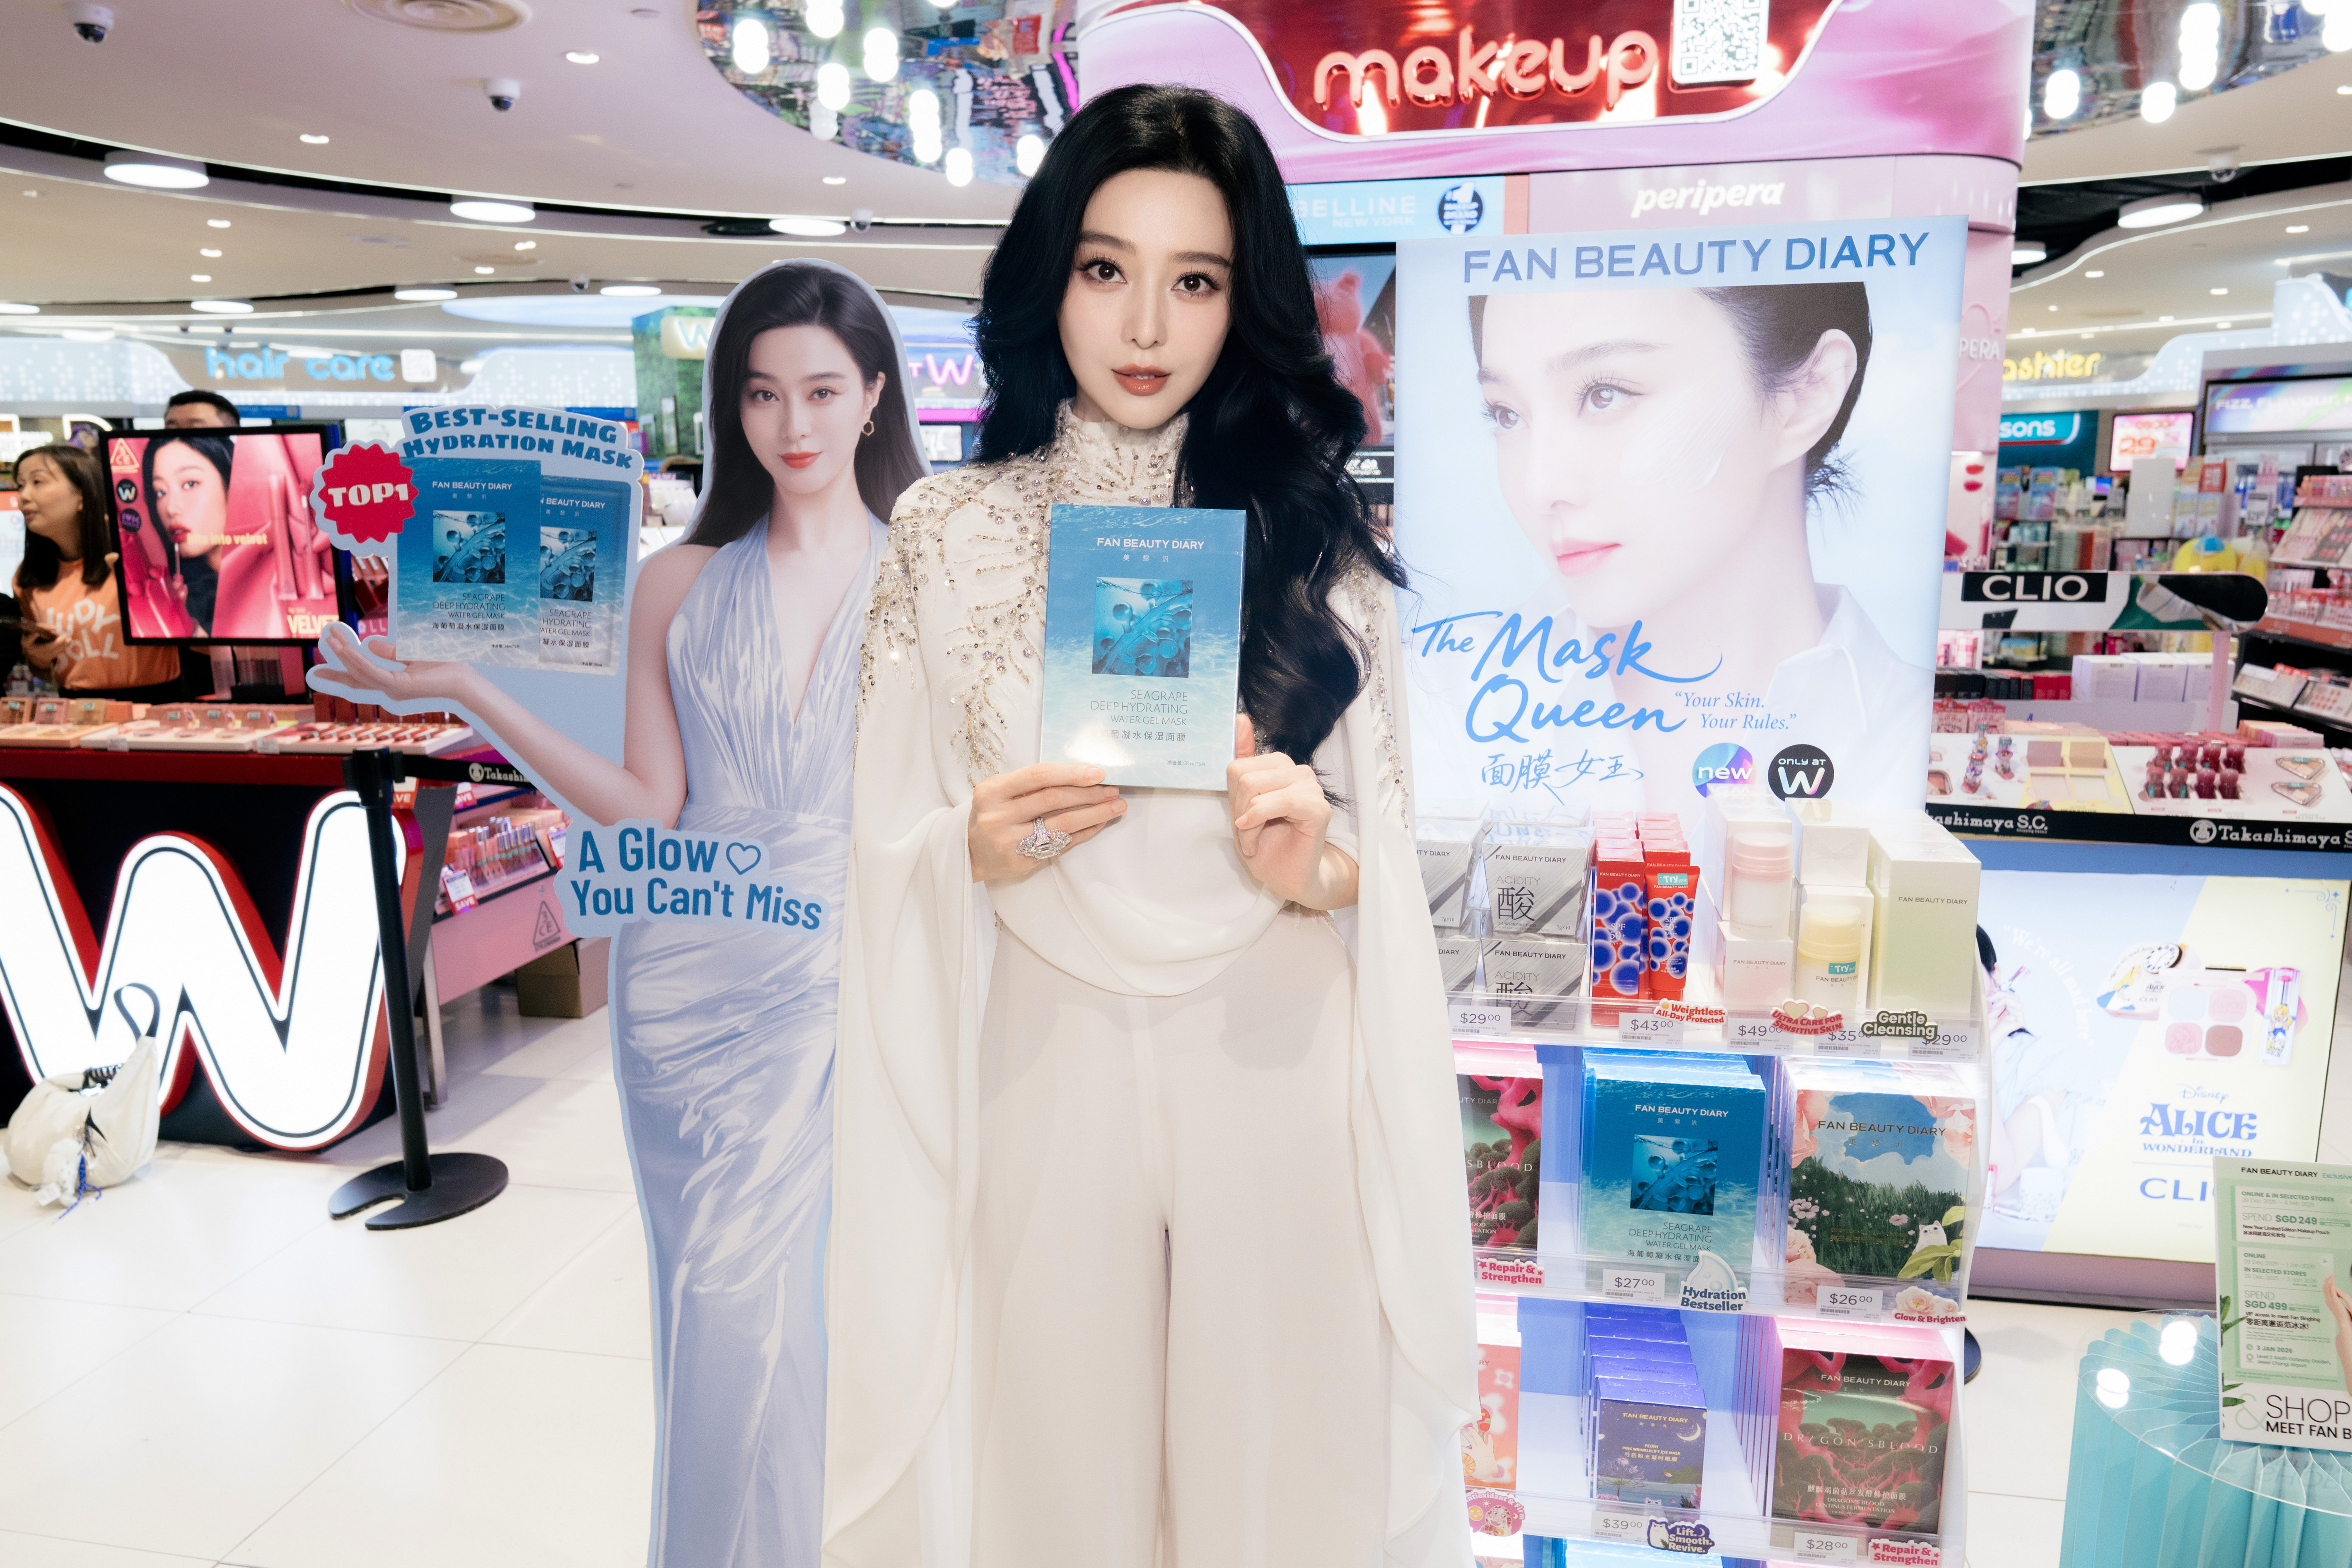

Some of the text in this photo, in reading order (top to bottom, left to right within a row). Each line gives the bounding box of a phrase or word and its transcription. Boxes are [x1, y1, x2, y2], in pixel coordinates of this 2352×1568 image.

[1314, 26, 1658, 109] makeup
[1631, 179, 1785, 218] peripera
[1294, 196, 1416, 218] BELLINE
[1332, 215, 1415, 228] NEW YORK
[1464, 232, 1929, 284] FAN BEAUTY DIARY
[1959, 337, 2000, 360] PERA
[206, 345, 396, 381] hair care
[2002, 349, 2101, 381] ashier
[409, 408, 617, 444] BEST-SELLING
[1999, 419, 2056, 438] sons
[402, 434, 633, 469] HYDRATION MASK
[452, 481, 486, 490] BEAUTY
[328, 483, 409, 508] TOP1
[211, 533, 232, 545] into
[1097, 538, 1205, 550] FAN BEAUTY DIARY
[1982, 575, 2089, 602] CLIO
[432, 622, 505, 631] 海葡萄凝水保湿面膜
[1411, 611, 1723, 684] The Mask
[1130, 690, 1188, 701] SEAGRAPE
[1674, 691, 1765, 708] “Your Skin.
[1091, 700, 1188, 714] DEEP HYDRATING
[1465, 674, 1688, 743] Queen
[1111, 715, 1187, 725] WATER GEL MASK
[1700, 713, 1797, 731] Your Rules.”
[1482, 747, 1644, 805] 面膜女王
[1699, 766, 1753, 780] new
[1777, 766, 1825, 795] W
[2218, 825, 2341, 849] Takashimaya
[579, 827, 719, 873] A Glow
[1496, 875, 1541, 886] ACIDITY
[1663, 875, 1678, 883] Try
[455, 896, 476, 911] SAVE
[570, 877, 823, 930] You Can't Miss
[1497, 886, 1536, 922] 酸
[1656, 1009, 1724, 1024] All-Day Protected
[1671, 1003, 1726, 1016] Weightless.
[1772, 1009, 1842, 1026] ULTRA CARE FOR
[1878, 1012, 1925, 1024] Gentle
[1772, 1019, 1843, 1034] SENSITIVE SKIN
[1863, 1023, 1936, 1041] Cleansing
[1635, 1104, 1729, 1118] FAN BEAUTY DIARY
[2139, 1102, 2258, 1140] ALICE
[2142, 1142, 2253, 1158] WONDERLAND
[2139, 1177, 2214, 1202] CLI
[2242, 1212, 2272, 1222] SPEND
[2275, 1215, 2297, 1223] SGD
[2299, 1216, 2318, 1225] 249
[1683, 1285, 1746, 1300] Hydration
[2244, 1290, 2275, 1300] SPEND
[1680, 1297, 1743, 1311] Bestseller
[2245, 1300, 2267, 1309] SGD
[2268, 1302, 2288, 1310] 499
[1894, 1312, 1916, 1322] Glow
[1926, 1315, 1966, 1324] Brighten
[2266, 1394, 2351, 1425] SHOP
[2266, 1420, 2338, 1439] MEET FAN
[1846, 1505, 1896, 1513] FERMENTATION
[1676, 1527, 1697, 1537] Lift.
[1668, 1534, 1712, 1546] Smooth.
[1668, 1542, 1706, 1554] Revive.
[1882, 1544, 1932, 1556] Repair &
[1874, 1553, 1938, 1566] Strengthen
